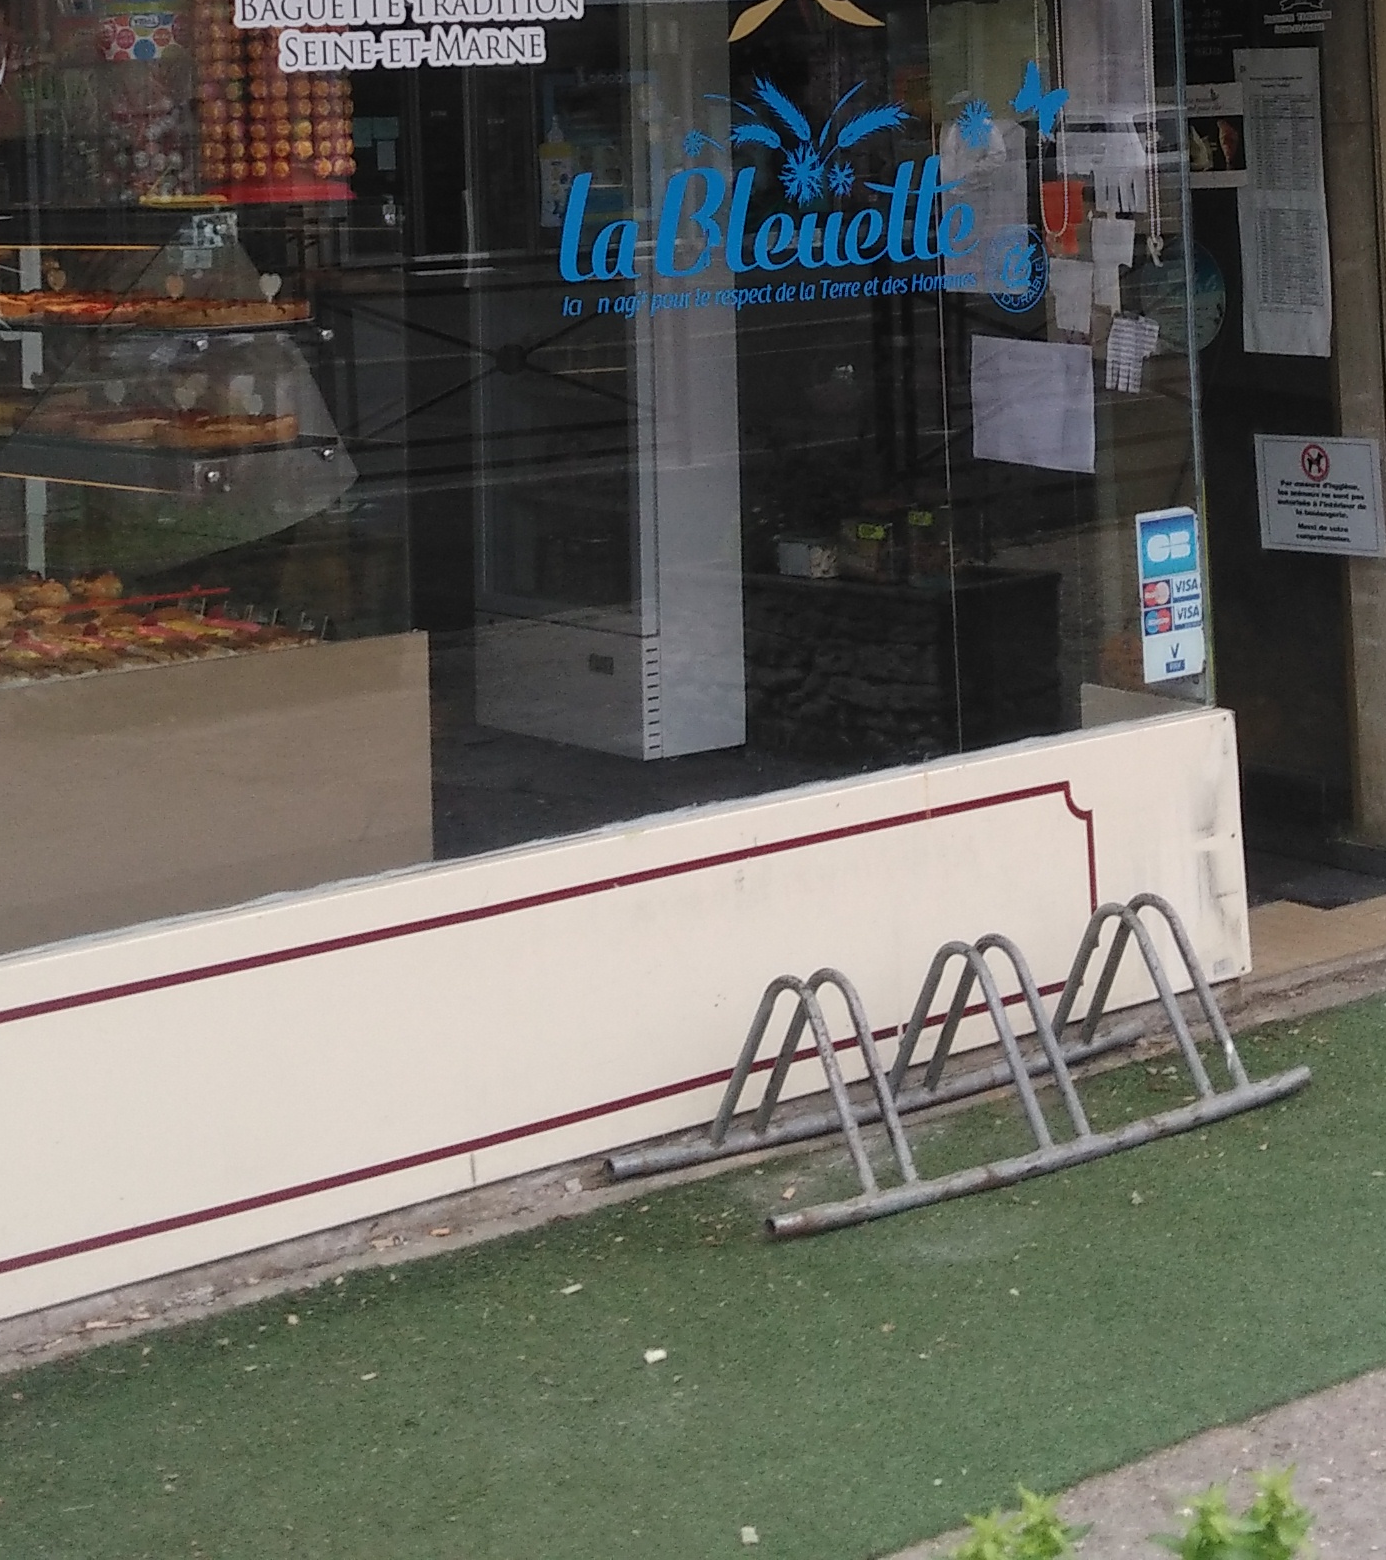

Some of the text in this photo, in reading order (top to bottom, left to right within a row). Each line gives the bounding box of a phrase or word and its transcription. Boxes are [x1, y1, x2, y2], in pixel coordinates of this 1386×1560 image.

[284, 28, 544, 68] SEINE-ET-MARNE
[559, 172, 642, 282] la
[655, 155, 981, 278] Bleuette
[714, 285, 772, 313] respect
[775, 283, 796, 303] de
[800, 281, 815, 301] la
[821, 278, 860, 299] Terre
[863, 279, 879, 297] et
[881, 274, 908, 295] des
[911, 272, 977, 294] Hommes
[1000, 261, 1044, 307] DURABLE
[1175, 577, 1199, 594] VISA
[1177, 604, 1200, 620] VISA
